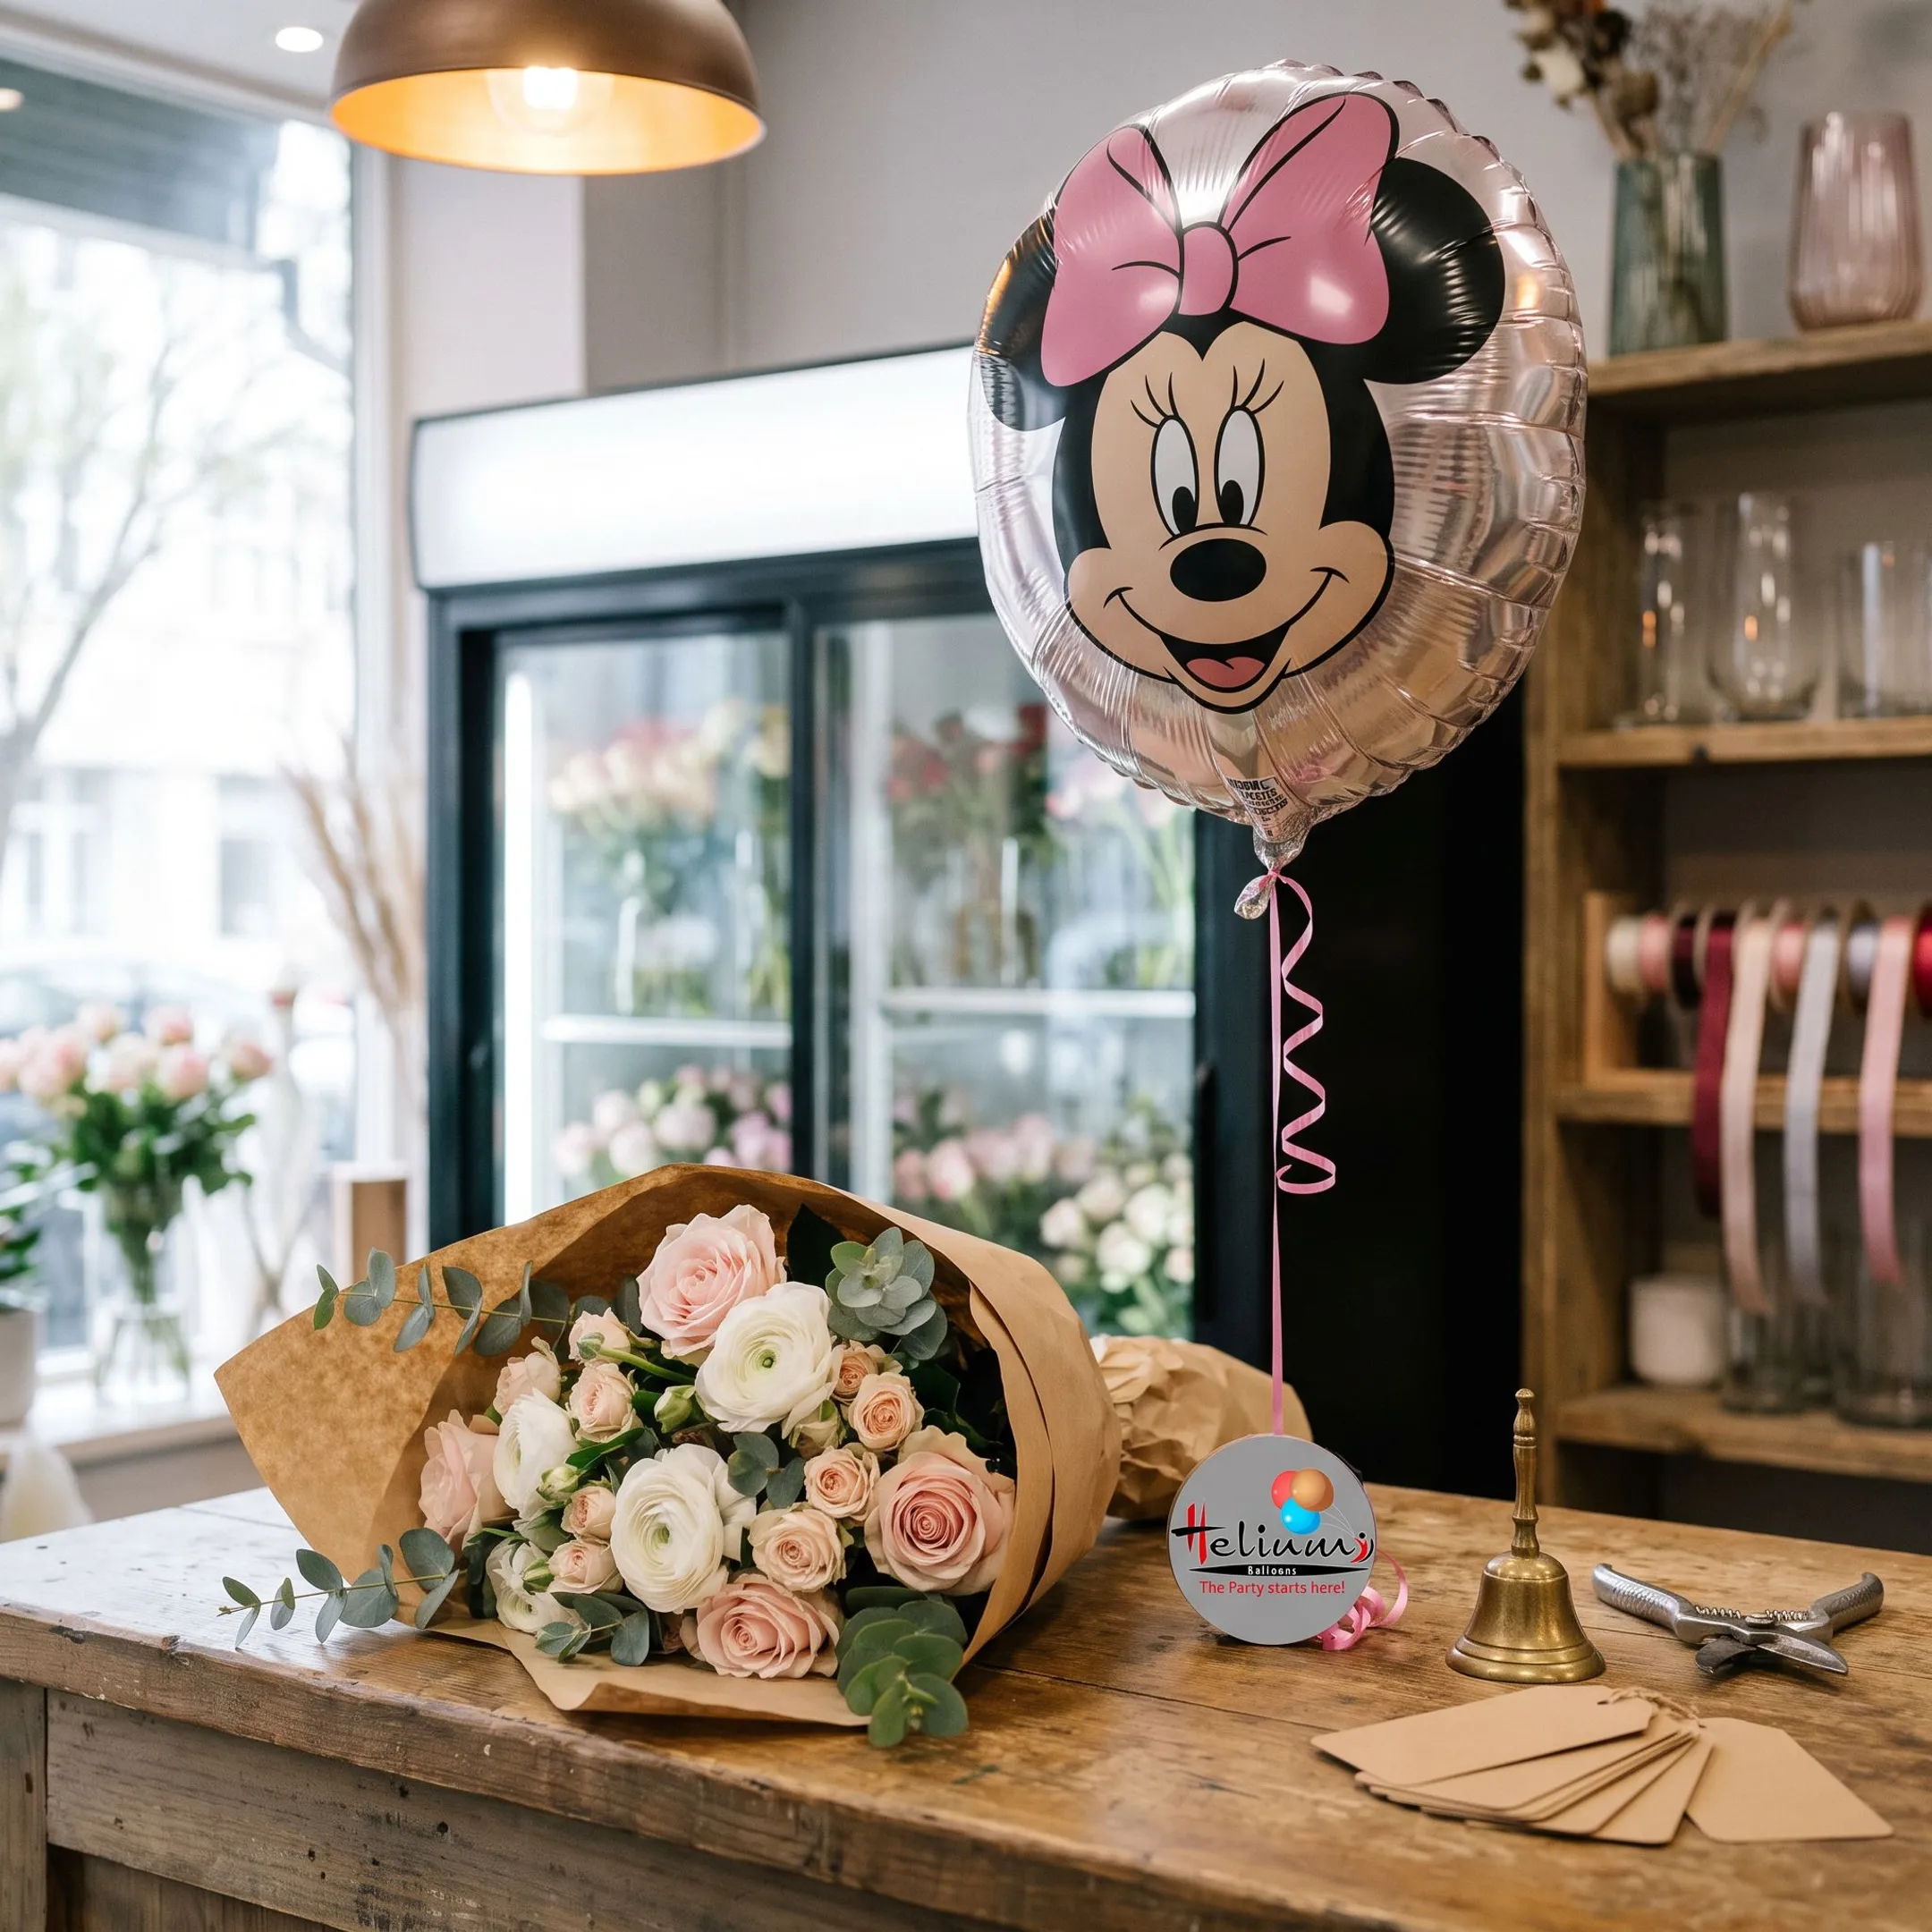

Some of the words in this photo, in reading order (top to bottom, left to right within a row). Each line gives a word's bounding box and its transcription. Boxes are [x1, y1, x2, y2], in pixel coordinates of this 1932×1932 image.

[1248, 1565, 1297, 1576] Balloons
[1199, 1580, 1224, 1594] The
[1229, 1580, 1264, 1597] Party
[1268, 1581, 1307, 1594] starts
[1310, 1580, 1345, 1594] here!
